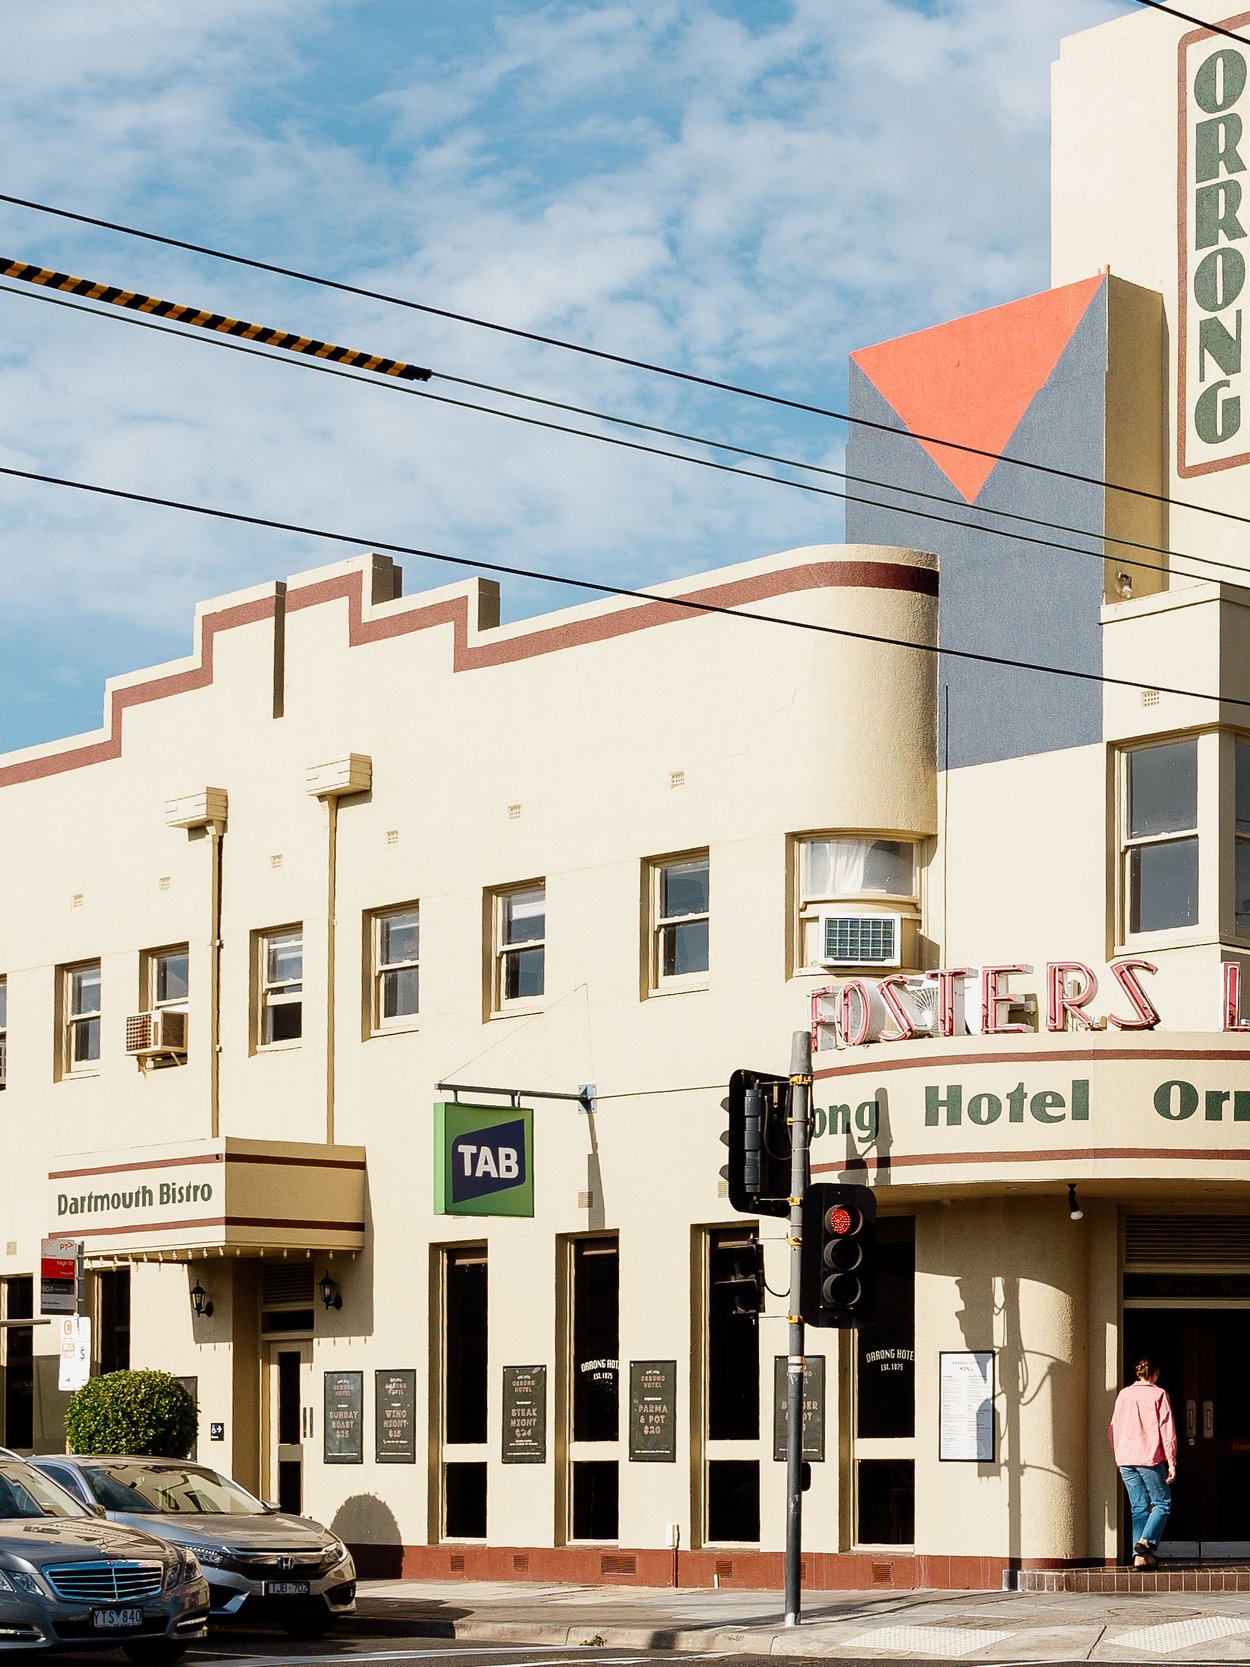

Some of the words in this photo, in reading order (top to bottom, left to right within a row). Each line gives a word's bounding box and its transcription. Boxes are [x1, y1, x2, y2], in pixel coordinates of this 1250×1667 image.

[1193, 48, 1248, 445] ORRONG
[808, 958, 1162, 1053] FOSTERS
[811, 1100, 880, 1144] ong
[924, 1079, 1090, 1127] Hotel
[457, 1144, 519, 1179] TAB
[57, 1185, 154, 1216] Dartmouth
[159, 1180, 213, 1206] Bistro
[866, 1349, 896, 1363] ORRONG
[896, 1349, 915, 1361] HOTE
[581, 1359, 606, 1372] ORRONG
[606, 1359, 619, 1370] HOT
[891, 1363, 903, 1371] 1875
[511, 1408, 538, 1417] STEAK
[638, 1404, 668, 1413] PARMA
[329, 1410, 359, 1419] SUNDAY
[648, 1415, 666, 1424] POT
[331, 1420, 355, 1429] ROAST
[510, 1418, 537, 1427] NIGHT
[643, 1425, 661, 1435] $20
[94, 1611, 115, 1625] YTS
[122, 1610, 142, 1623] 840
